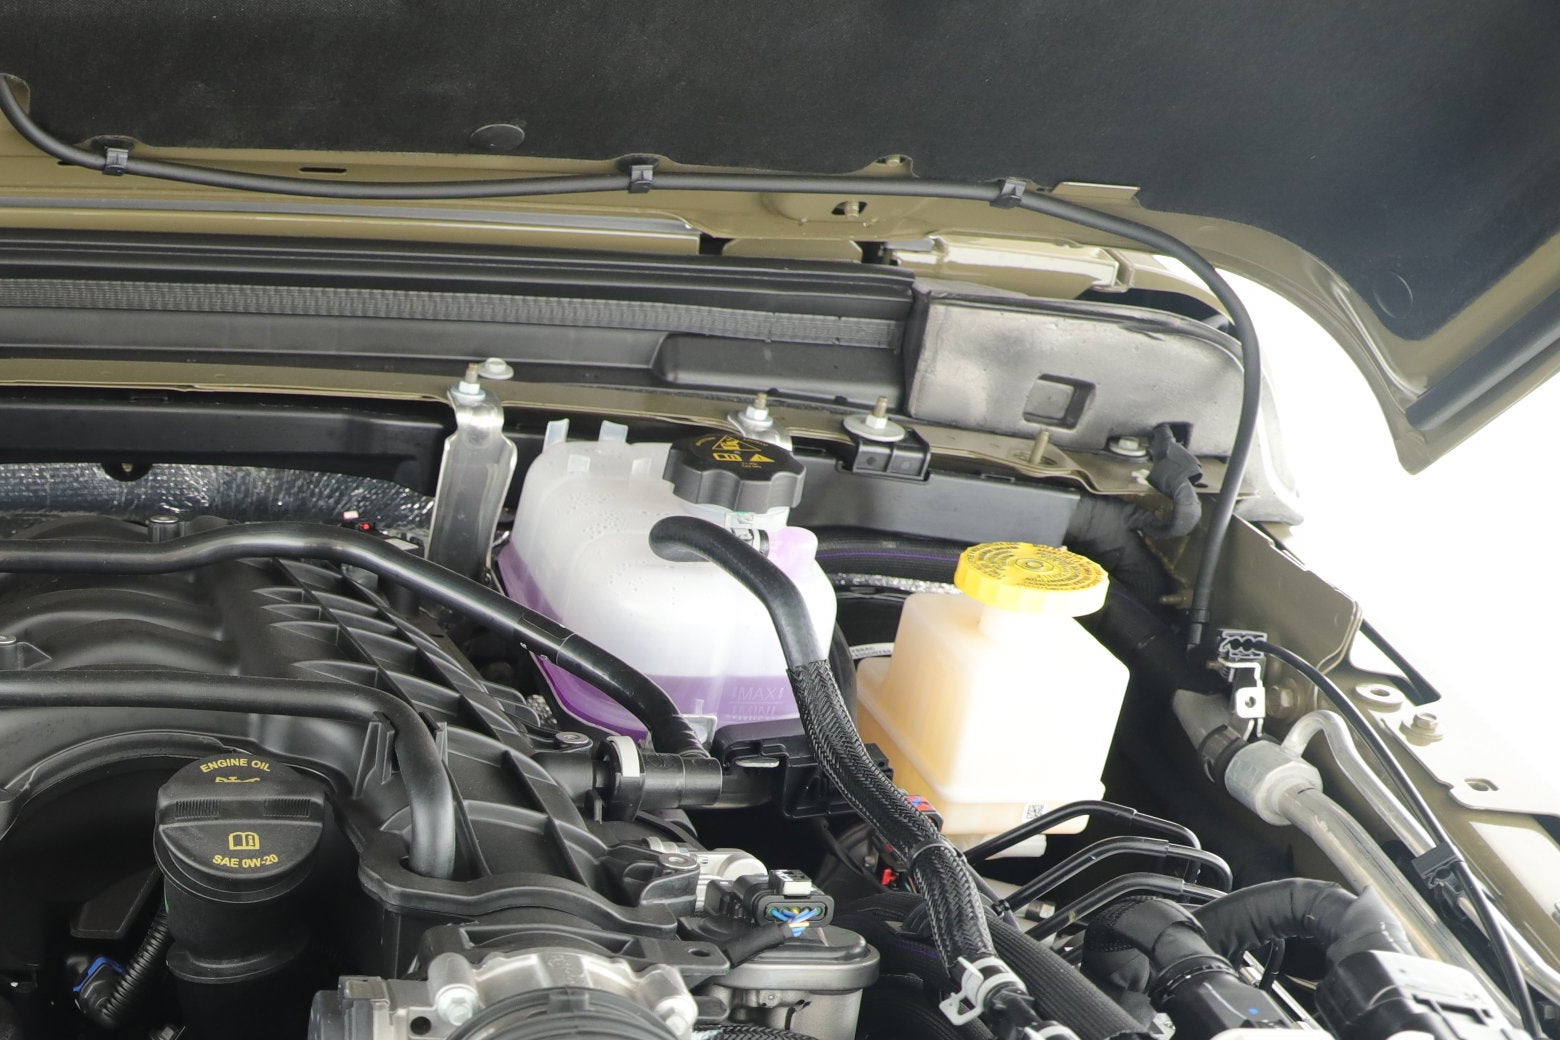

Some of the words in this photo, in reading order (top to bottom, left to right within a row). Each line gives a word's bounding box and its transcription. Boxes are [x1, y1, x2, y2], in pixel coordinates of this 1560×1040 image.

[737, 687, 775, 700] MAX
[200, 758, 248, 773] ENGINE
[251, 760, 271, 772] OIL
[213, 855, 239, 867] SAE
[242, 854, 278, 867] 0W-20
